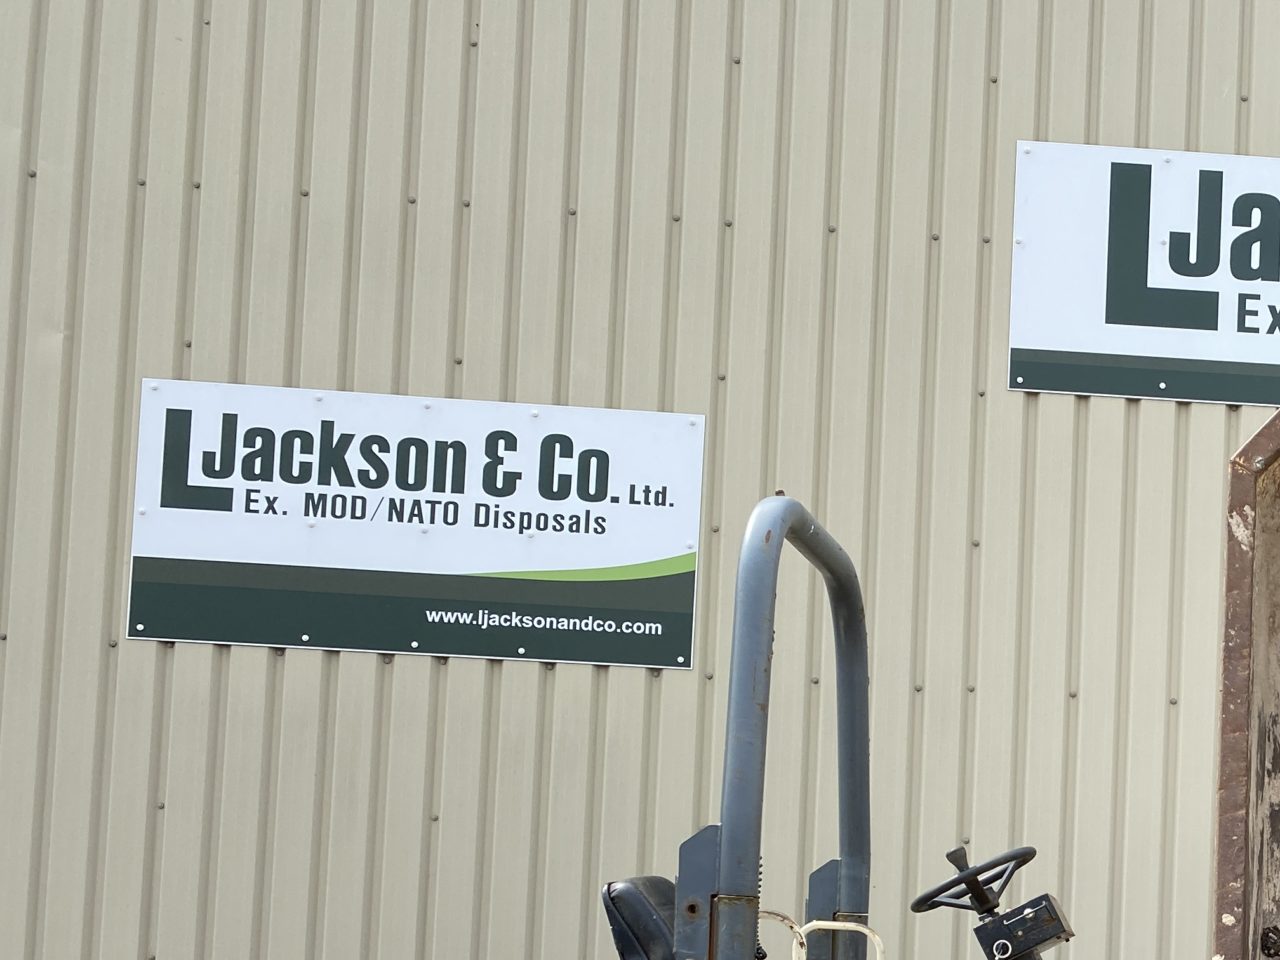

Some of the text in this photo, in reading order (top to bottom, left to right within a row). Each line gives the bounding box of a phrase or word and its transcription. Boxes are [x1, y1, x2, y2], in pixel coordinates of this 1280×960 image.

[482, 430, 522, 497] &
[538, 433, 620, 504] Co.
[628, 484, 675, 508] Ltd.
[244, 489, 607, 535] Ex. MOD/NATO Disposals
[426, 609, 663, 635] www.ljacksonandco.com
